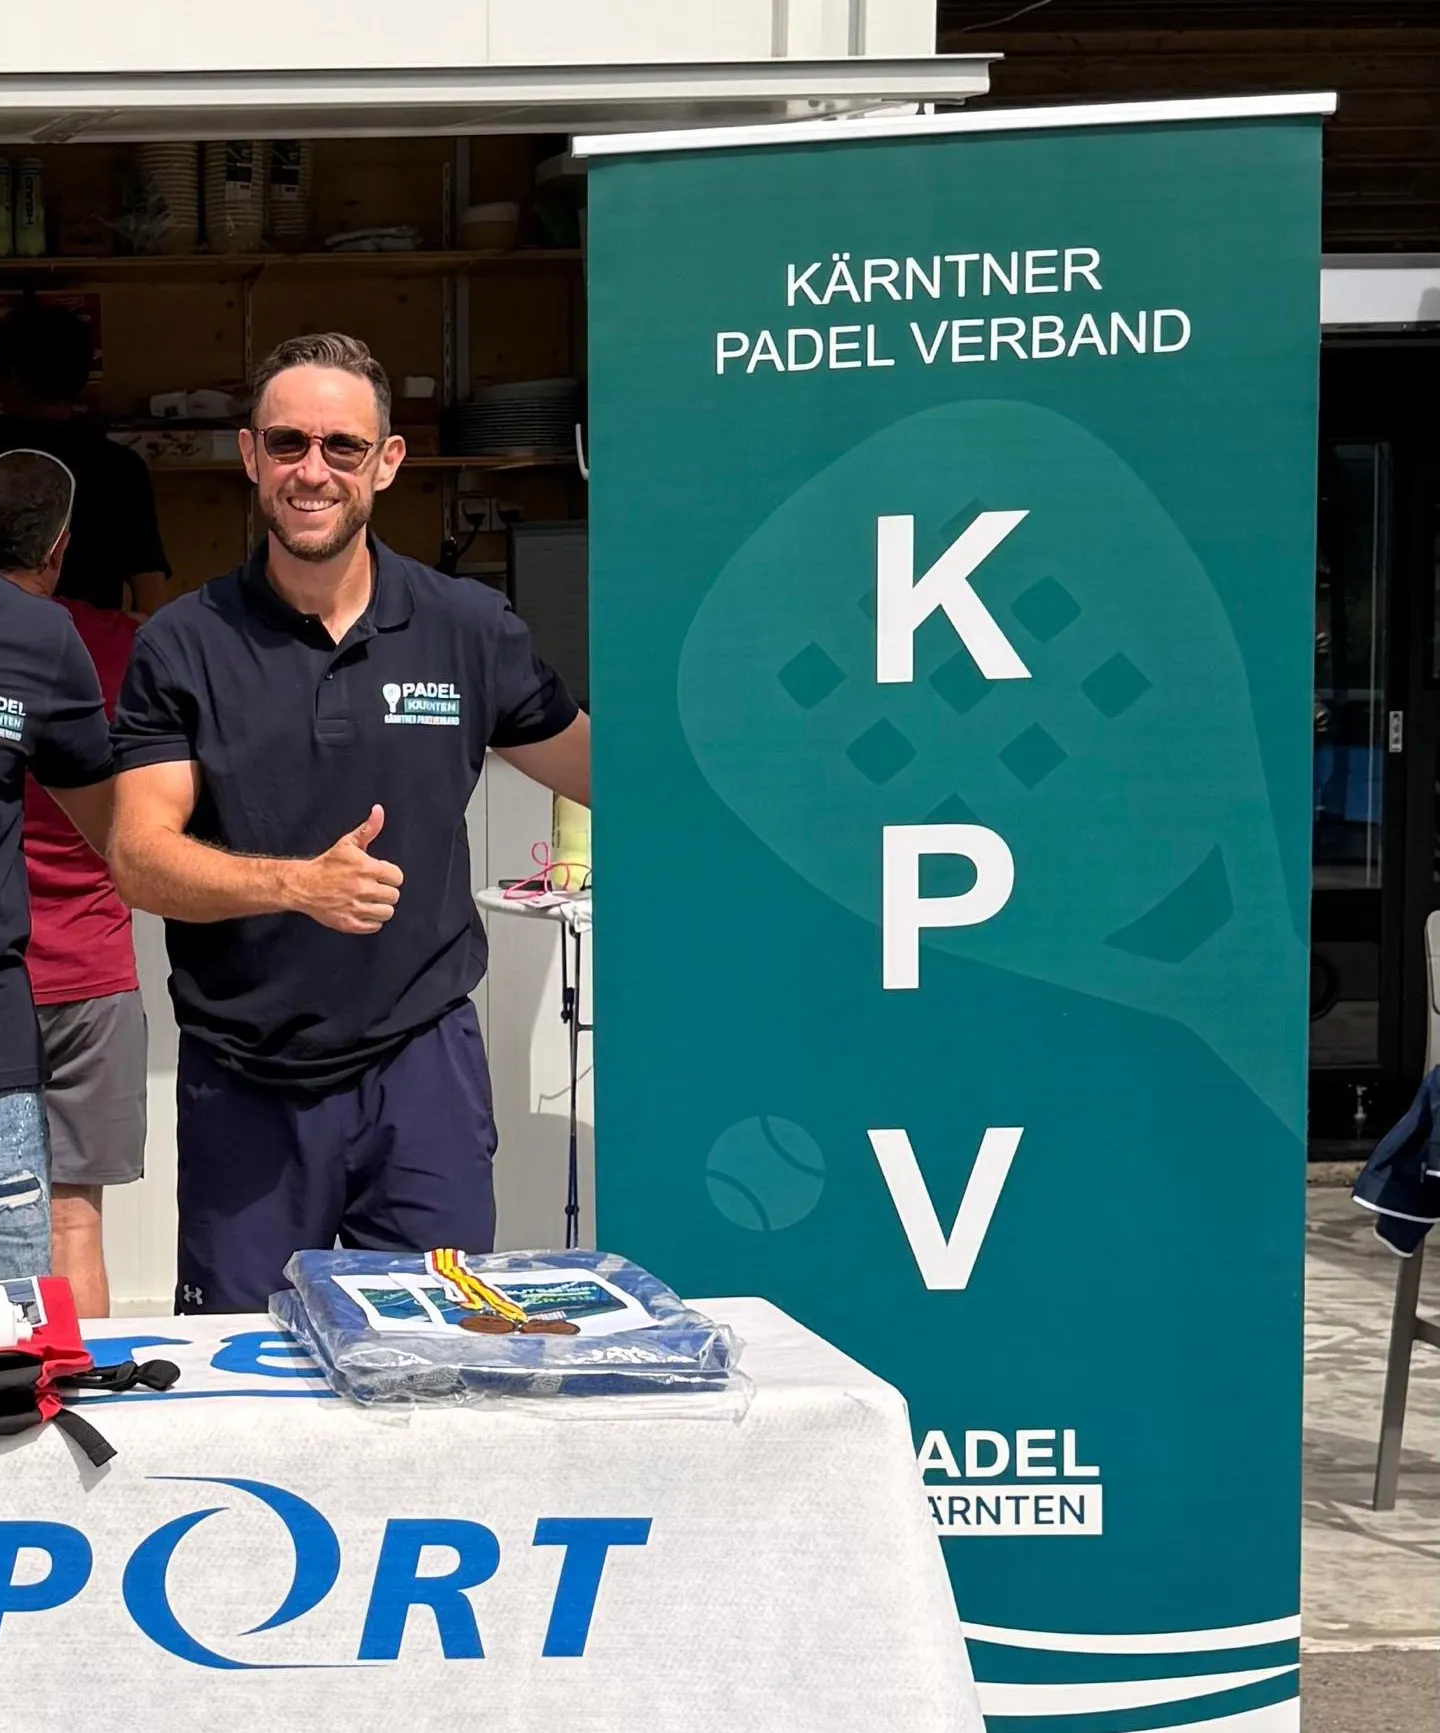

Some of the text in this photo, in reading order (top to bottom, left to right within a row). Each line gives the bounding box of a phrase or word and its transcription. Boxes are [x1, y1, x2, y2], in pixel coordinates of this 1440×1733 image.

[787, 247, 1102, 307] KÄRNTNER
[715, 308, 1191, 375] PADEL VERBAND
[402, 682, 460, 699] PADEL
[866, 509, 1032, 1290] K P V
[917, 1429, 1100, 1478] ADEL
[927, 1495, 1085, 1525] ÄRNTEN
